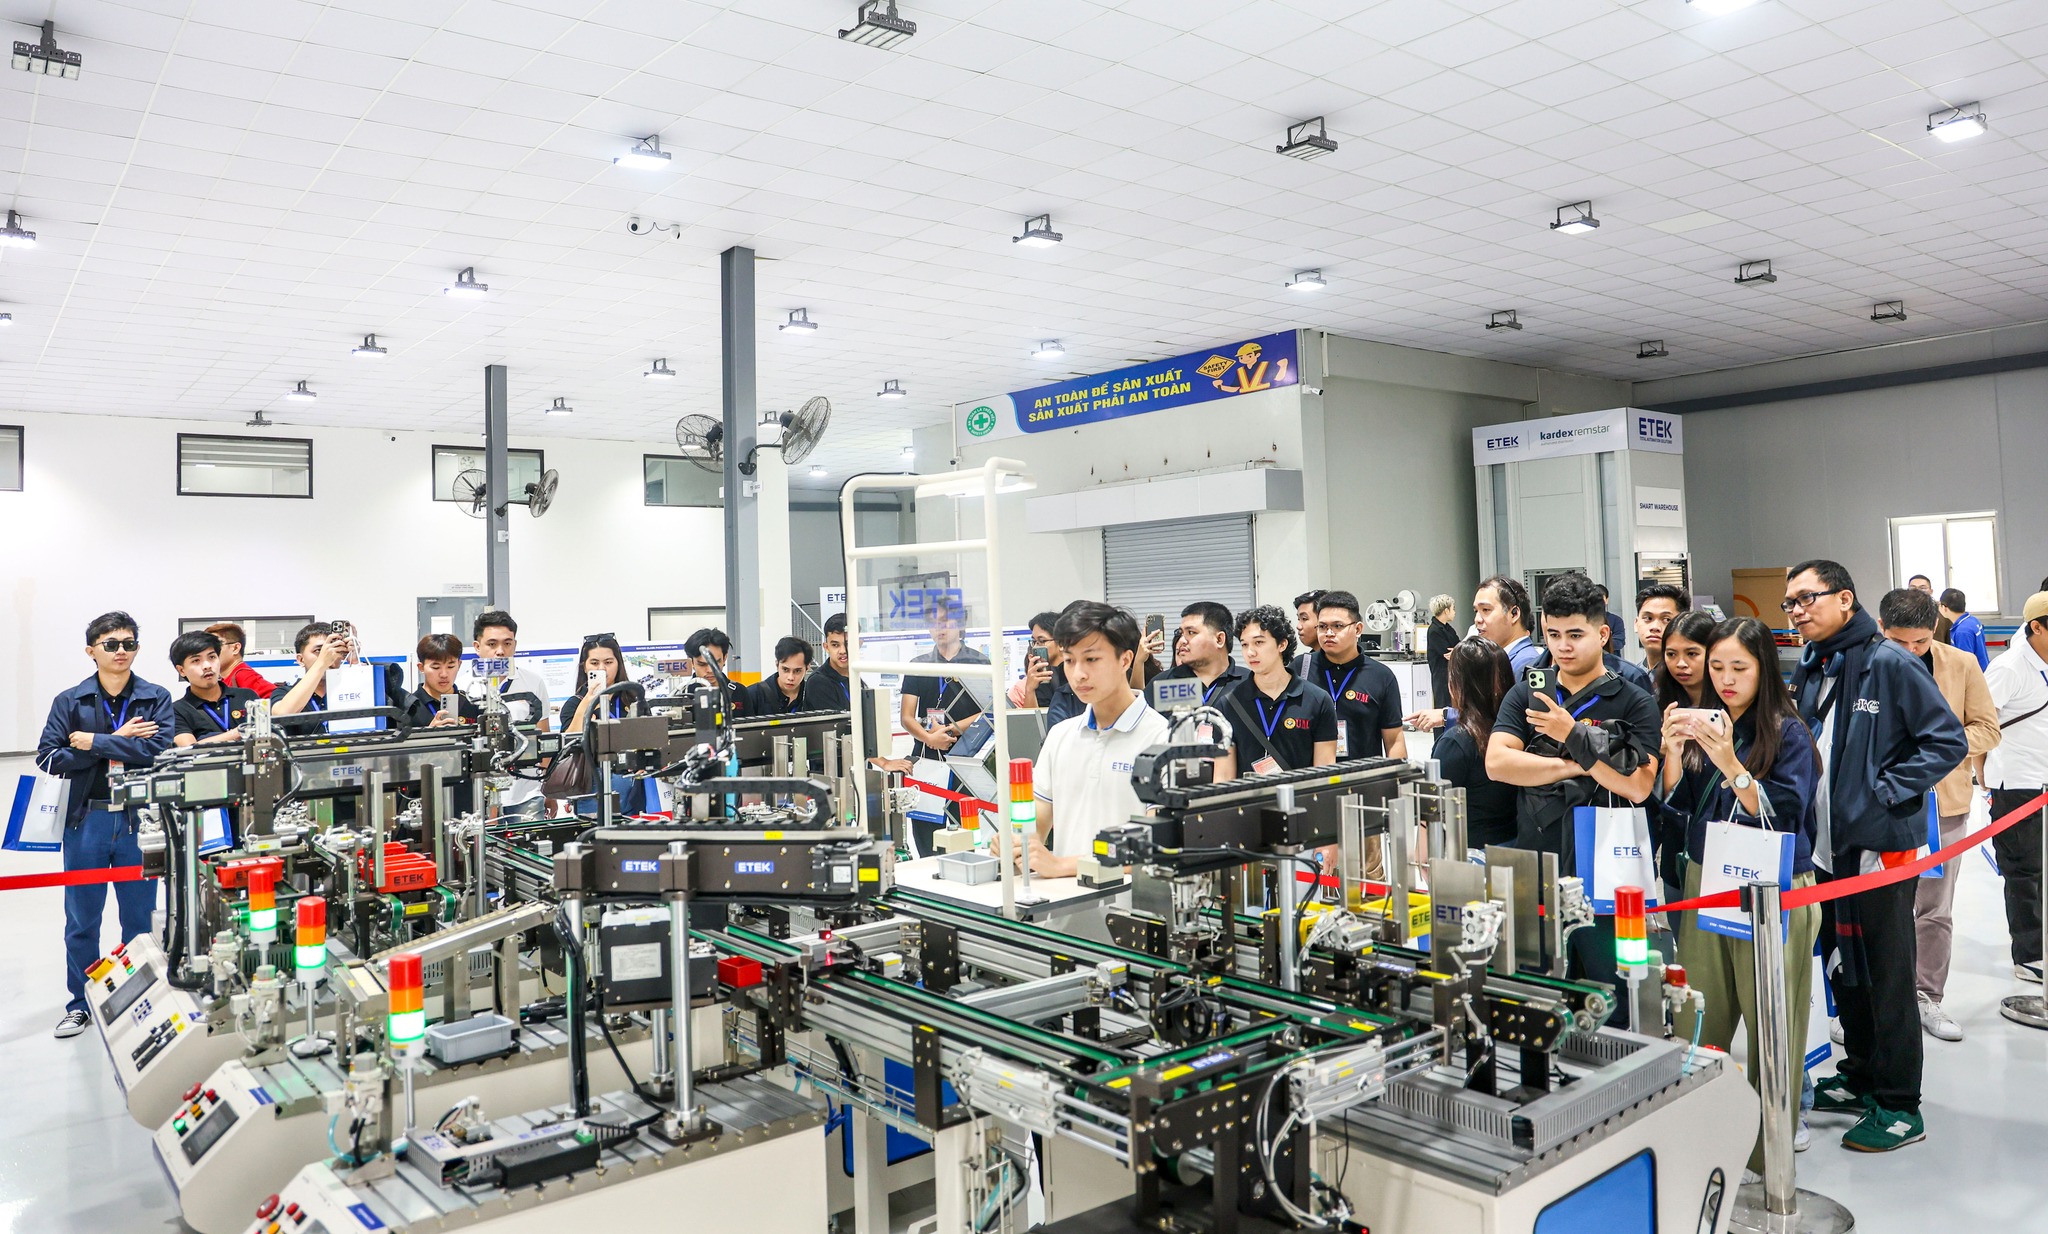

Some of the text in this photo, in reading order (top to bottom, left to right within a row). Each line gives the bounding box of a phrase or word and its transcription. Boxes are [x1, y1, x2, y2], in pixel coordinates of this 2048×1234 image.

[1204, 361, 1228, 370] SAFETY
[1034, 367, 1182, 408] AN TOÀN ĐỂ SẢN XUẤT
[1028, 382, 1191, 422] SẢN XUẤT PHẢI AN TOÀN
[1639, 417, 1672, 439] ETEK
[1487, 436, 1519, 448] ETEK
[476, 660, 509, 670] ETEK
[657, 662, 687, 671] ETEK
[339, 692, 361, 700] ETEK
[1160, 683, 1196, 699] ETEK
[1356, 692, 1369, 703] UM
[1295, 718, 1310, 729] UM
[332, 766, 362, 776] ETEK
[625, 861, 657, 871] ETEK
[738, 862, 770, 872] ETEK
[1723, 864, 1760, 880] ETEK
[394, 873, 424, 885] ETEK
[1412, 911, 1430, 926] ETE
[518, 1124, 564, 1139] ETEK
